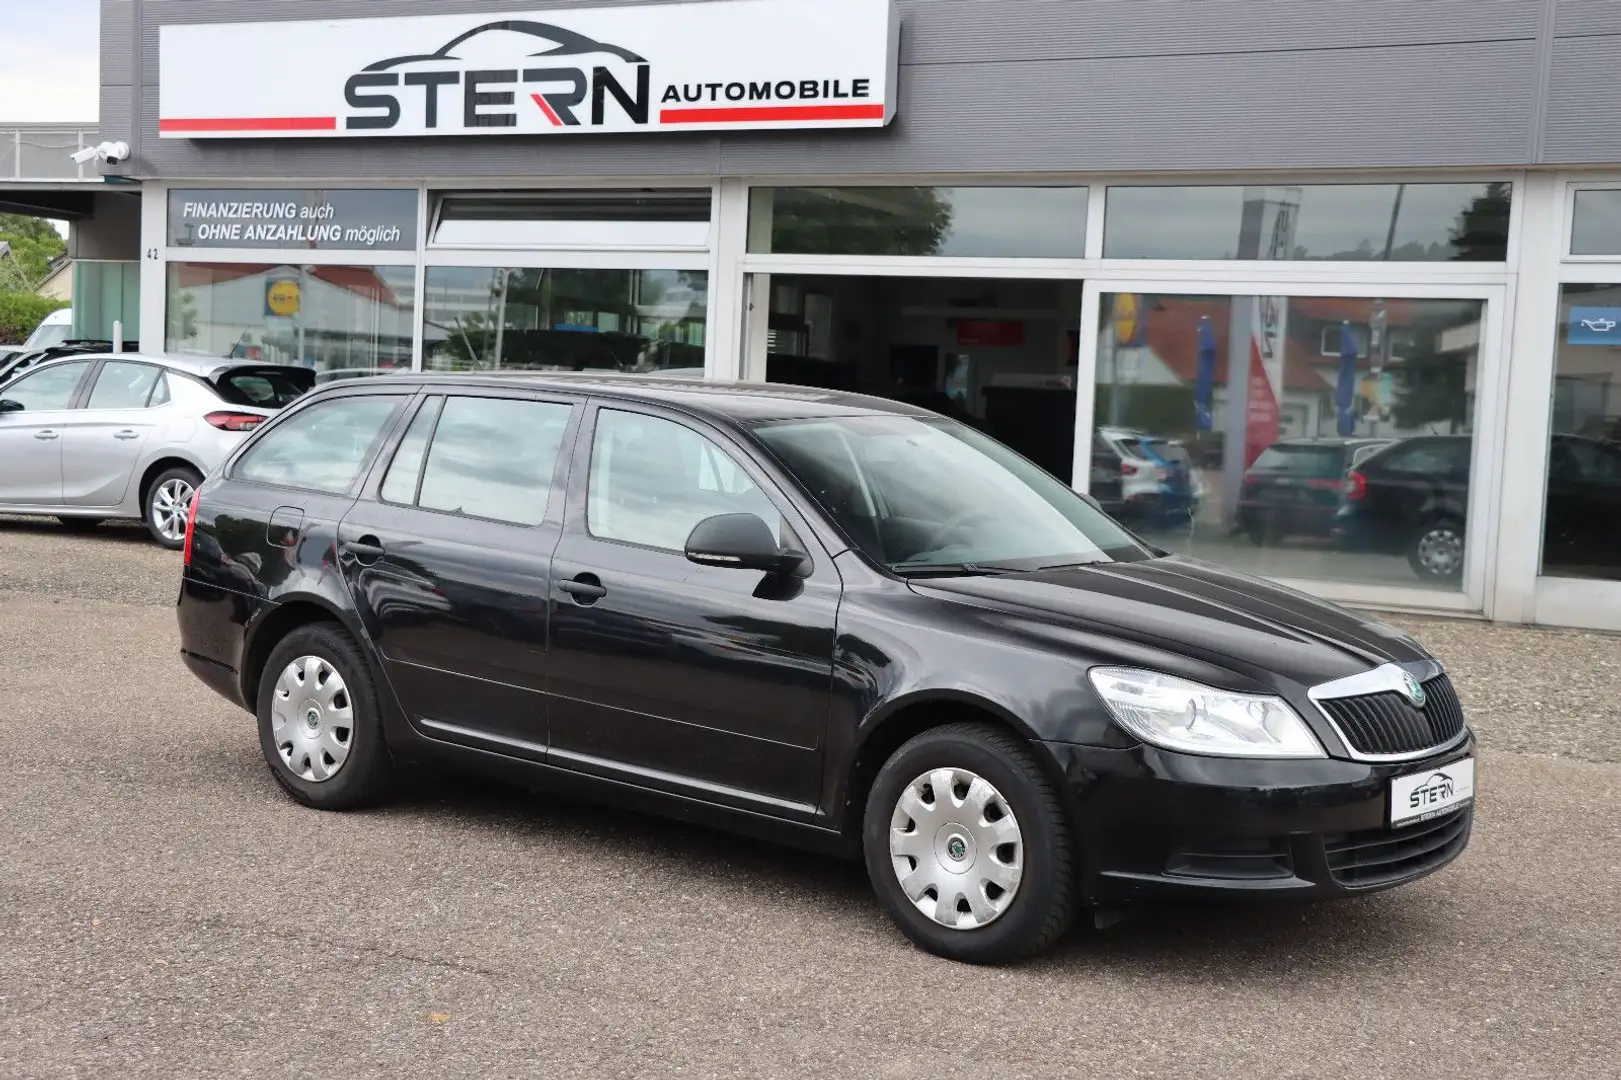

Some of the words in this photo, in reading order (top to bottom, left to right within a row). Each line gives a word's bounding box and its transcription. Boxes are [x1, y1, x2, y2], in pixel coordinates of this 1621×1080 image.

[344, 65, 650, 130] STERN
[661, 78, 870, 103] AUTOMOBILE
[183, 202, 297, 219] FINANZIERUNG
[300, 203, 335, 220] auch
[198, 224, 241, 241] OHNE
[244, 224, 342, 242] ANZAHLUNG
[345, 224, 401, 247] möglich
[1410, 782, 1454, 809] STERN
